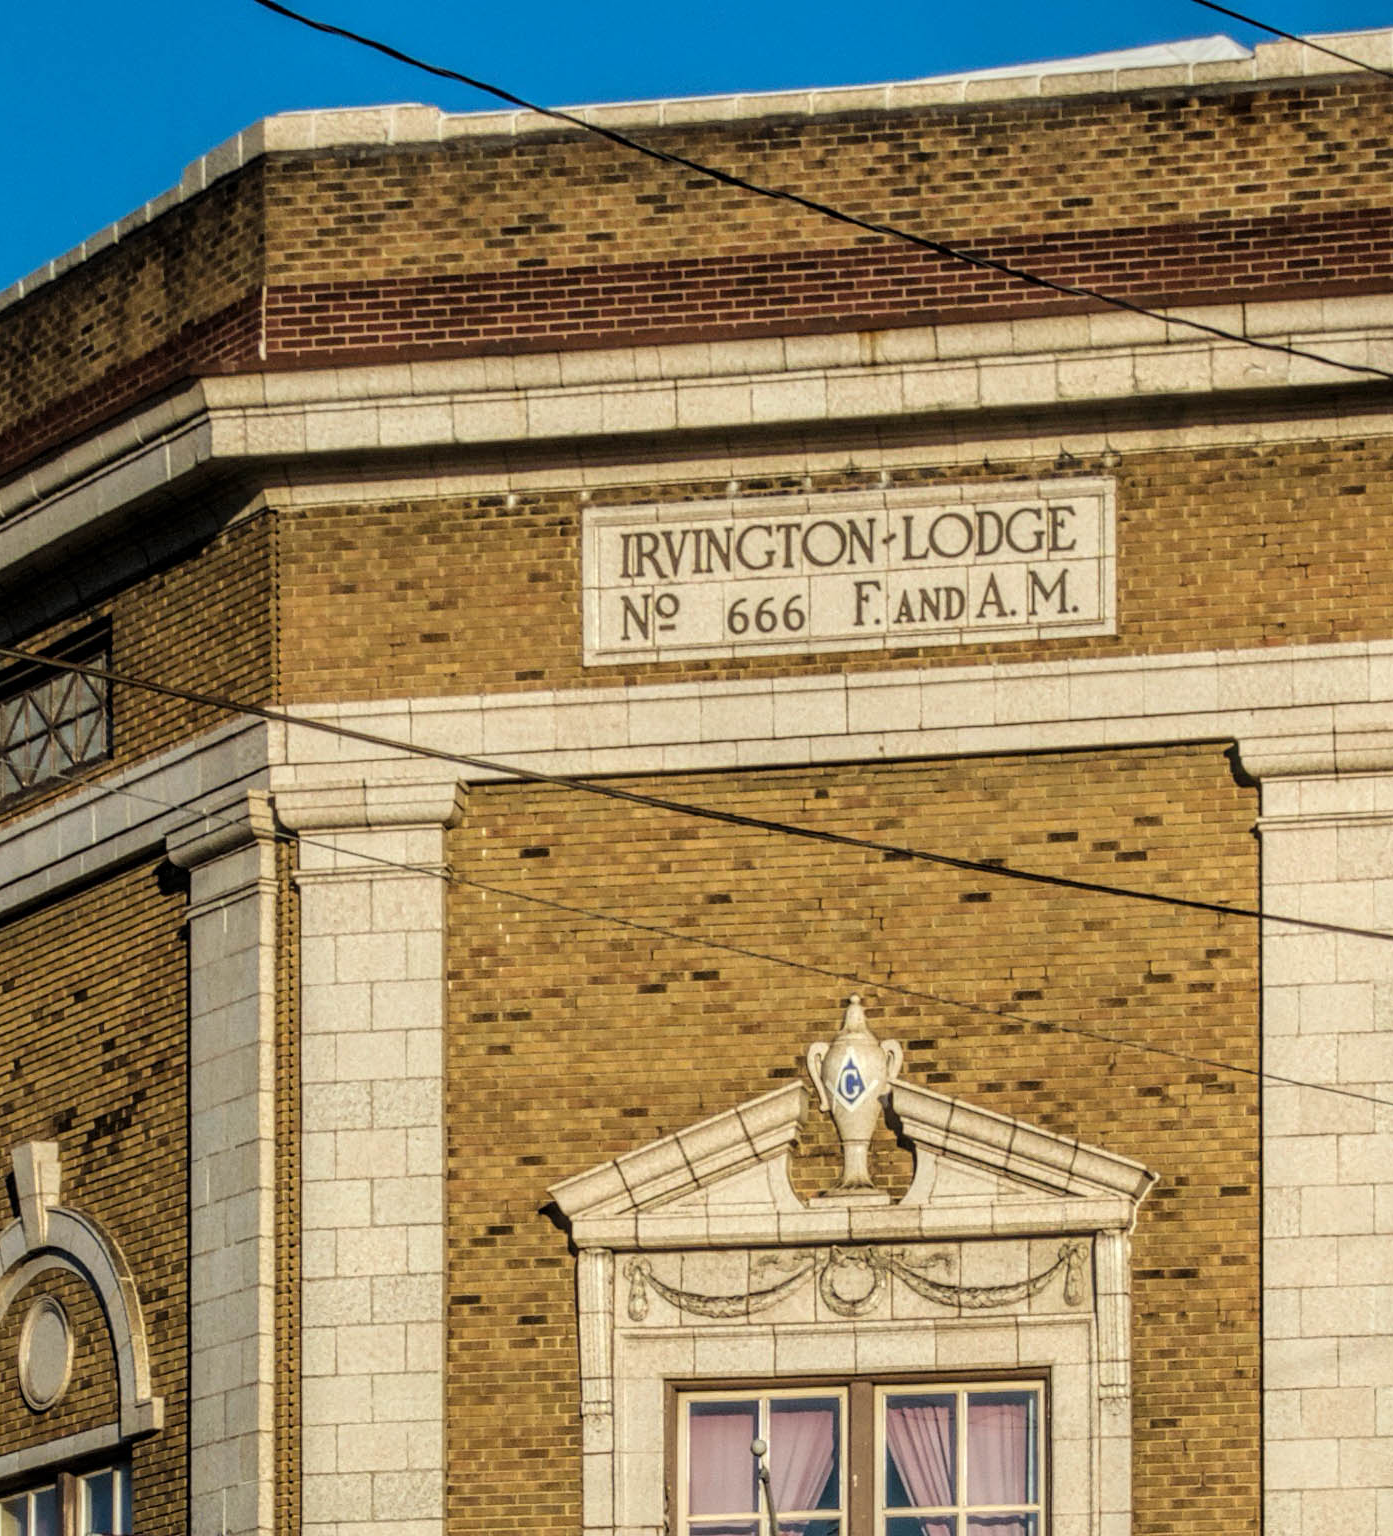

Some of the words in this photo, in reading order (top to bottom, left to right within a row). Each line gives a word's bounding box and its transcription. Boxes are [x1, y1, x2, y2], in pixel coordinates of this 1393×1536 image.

[726, 593, 806, 635] 666
[853, 580, 882, 627] F.
[893, 587, 966, 623] AND
